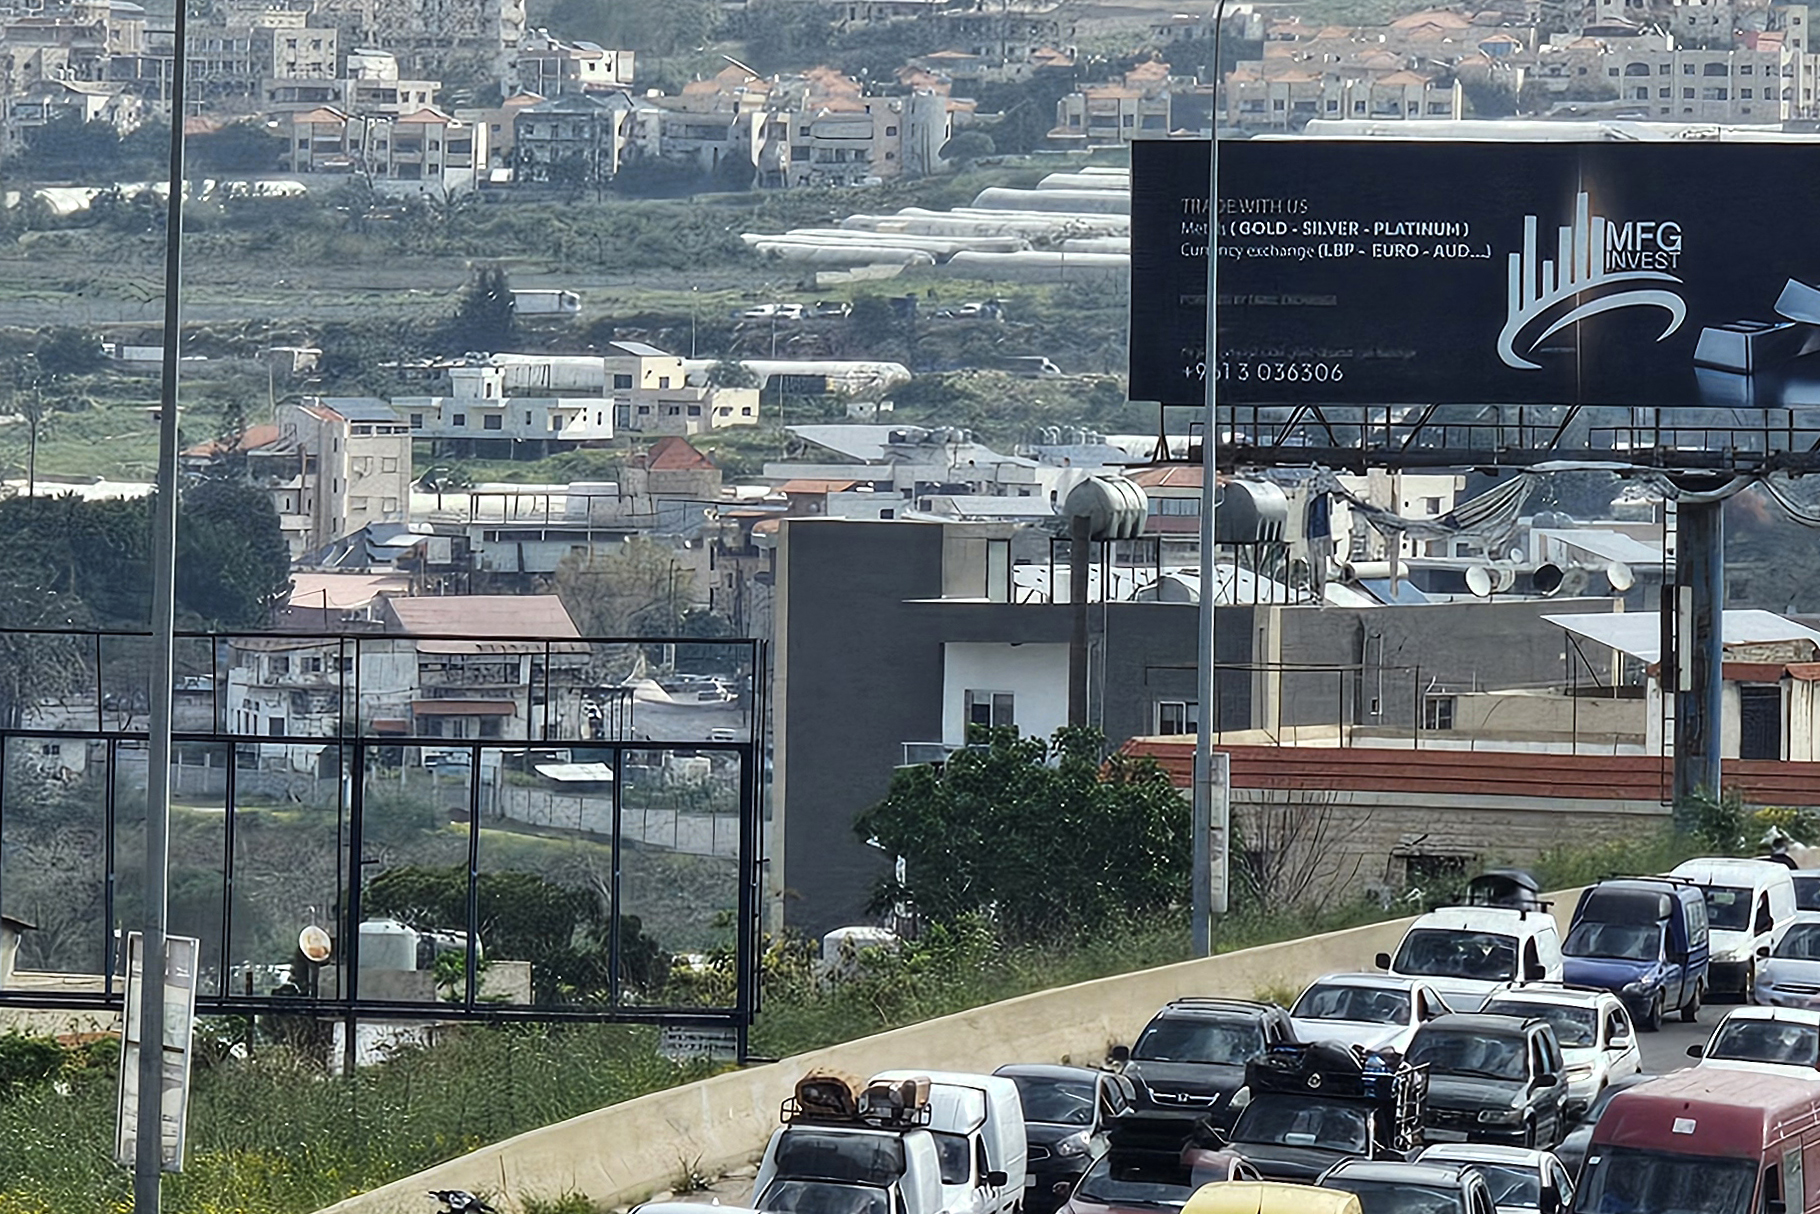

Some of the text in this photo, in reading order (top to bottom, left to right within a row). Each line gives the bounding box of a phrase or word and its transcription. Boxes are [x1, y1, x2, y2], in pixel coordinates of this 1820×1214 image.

[1239, 198, 1281, 213] WITH
[1286, 198, 1308, 213] US
[1302, 221, 1359, 236] SILVER
[1606, 220, 1682, 251] MFG
[1246, 243, 1315, 261] exchange
[1318, 243, 1355, 258] (LBP
[1371, 243, 1420, 258] EURO
[1605, 251, 1681, 269] INVEST
[1238, 363, 1250, 381] 3
[1257, 363, 1344, 382] 036306
